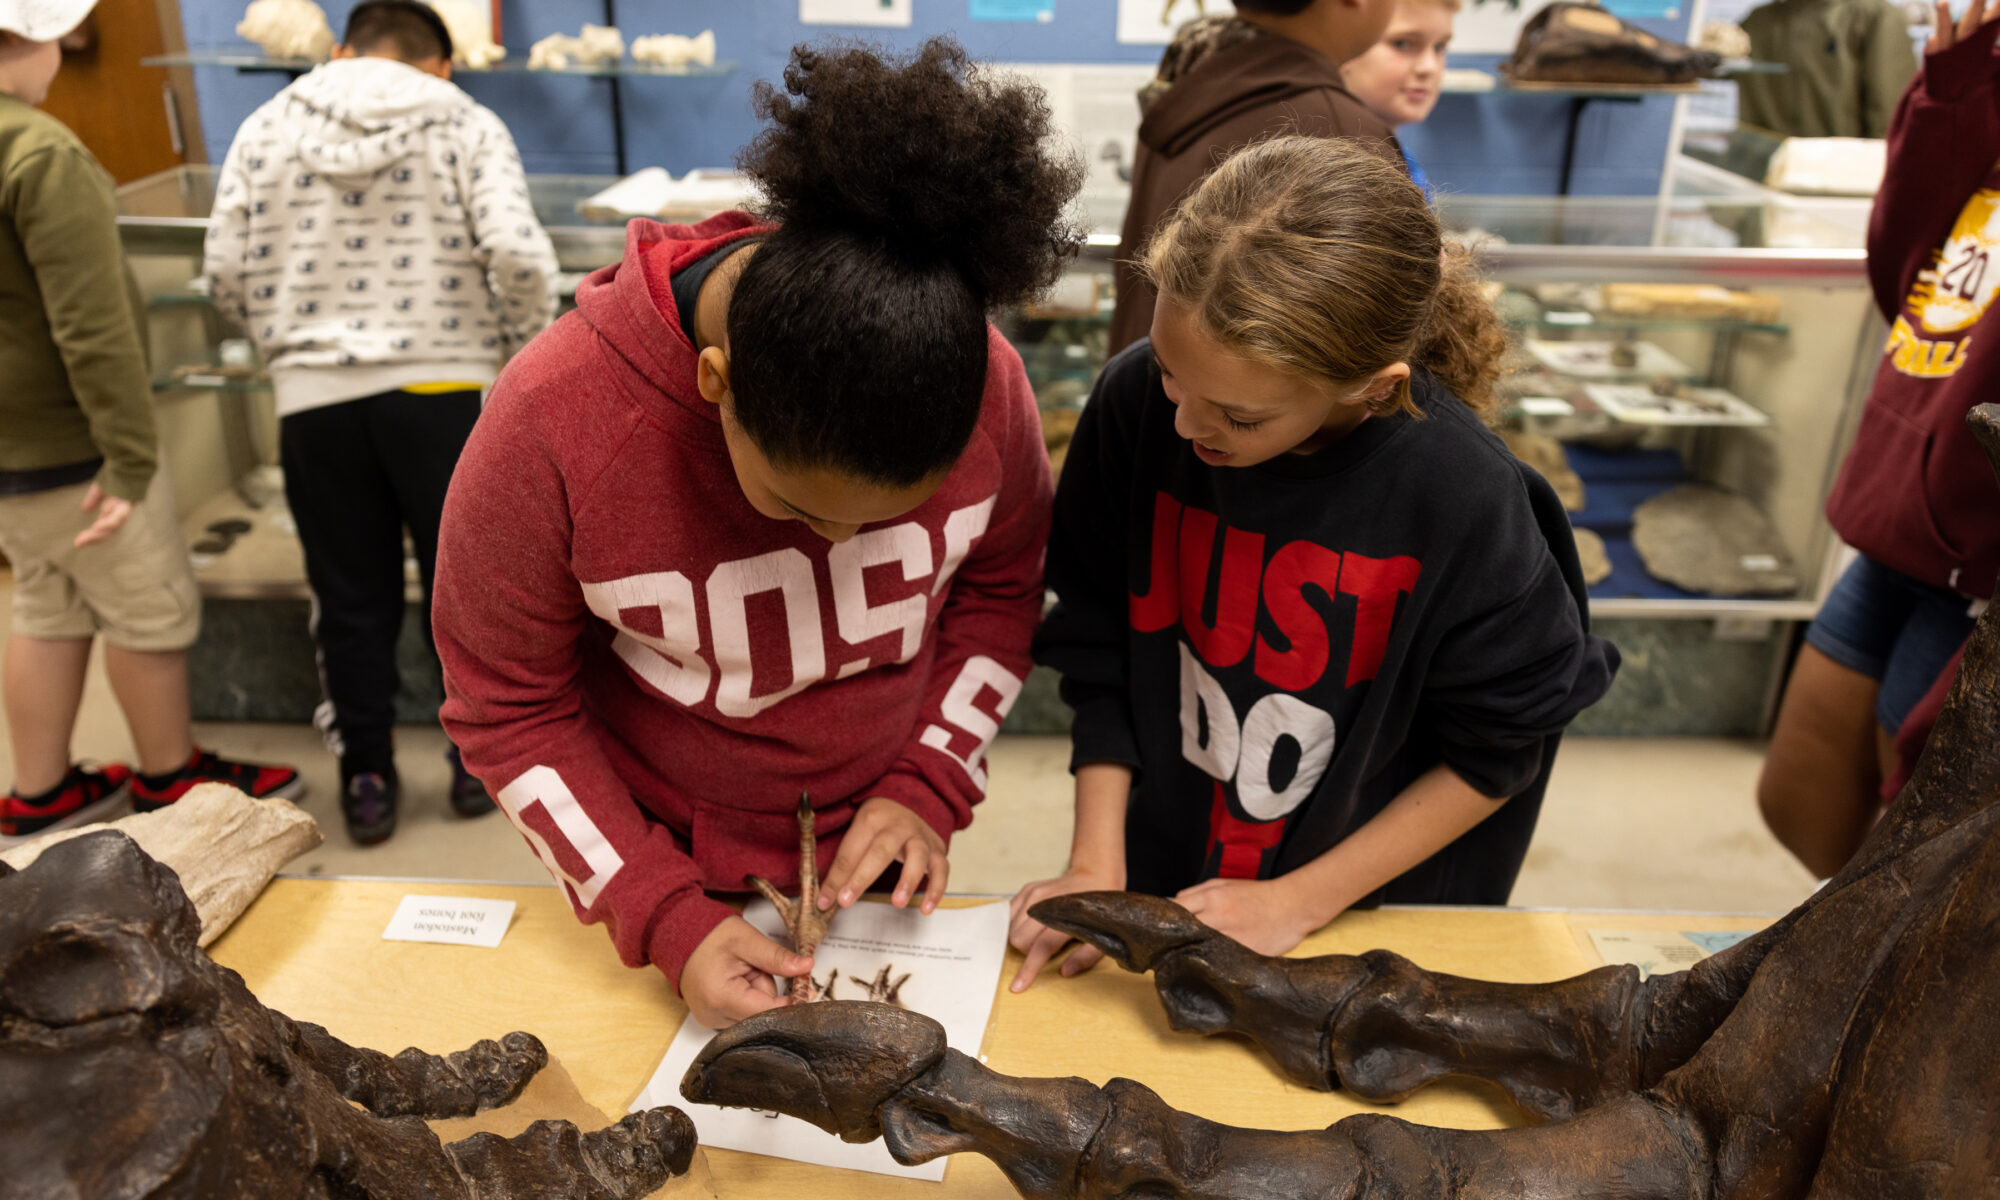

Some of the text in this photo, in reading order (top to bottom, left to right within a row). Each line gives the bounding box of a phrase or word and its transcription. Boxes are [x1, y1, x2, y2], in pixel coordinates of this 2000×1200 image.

[1129, 490, 1423, 691] JUST
[1178, 640, 1335, 820] DO
[414, 922, 477, 935] Mastodon
[419, 909, 486, 922] foot bones
